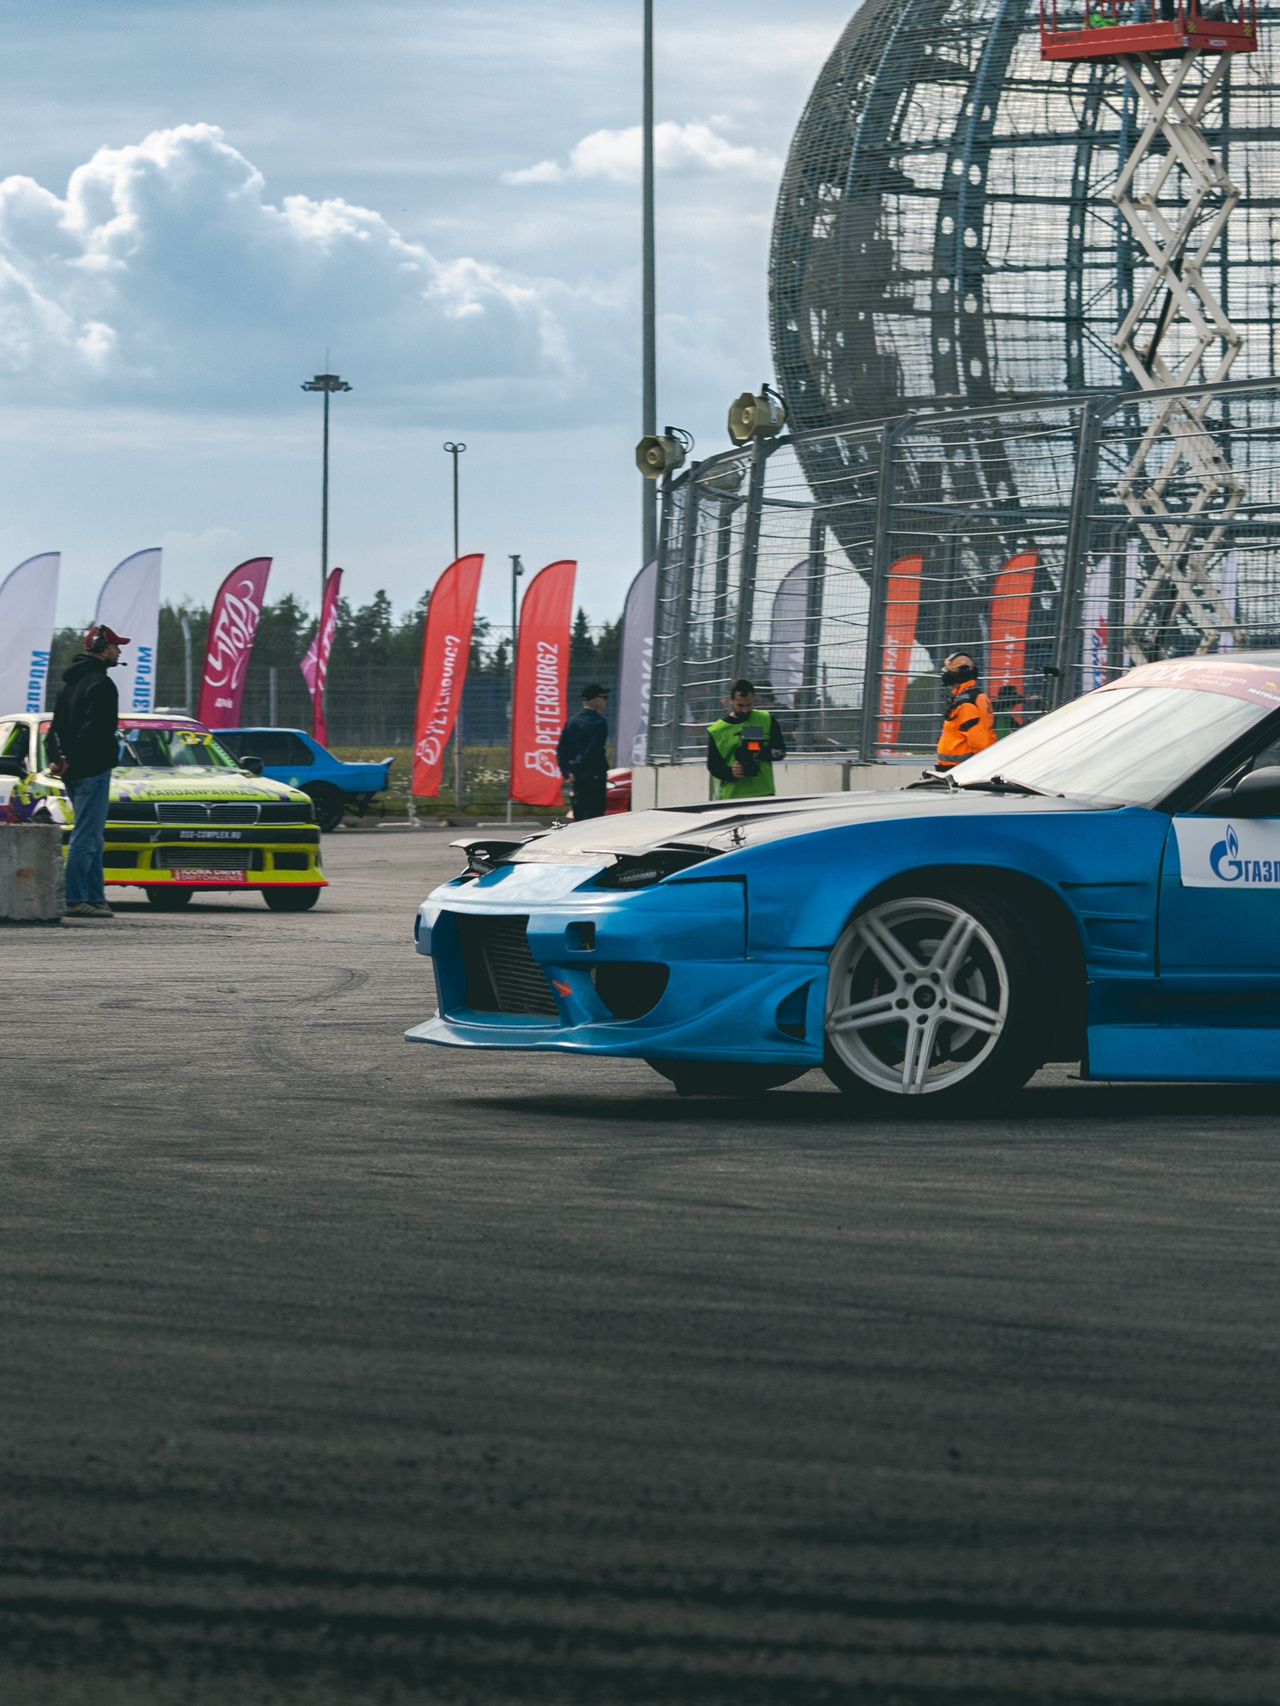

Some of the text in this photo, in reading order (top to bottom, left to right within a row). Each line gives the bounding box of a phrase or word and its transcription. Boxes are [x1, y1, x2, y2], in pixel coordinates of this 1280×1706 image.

[26, 650, 50, 713] ЗПРОМ
[133, 646, 152, 713] ЗПРОМ
[534, 641, 561, 746] PETERBURG2
[177, 730, 214, 746] 37
